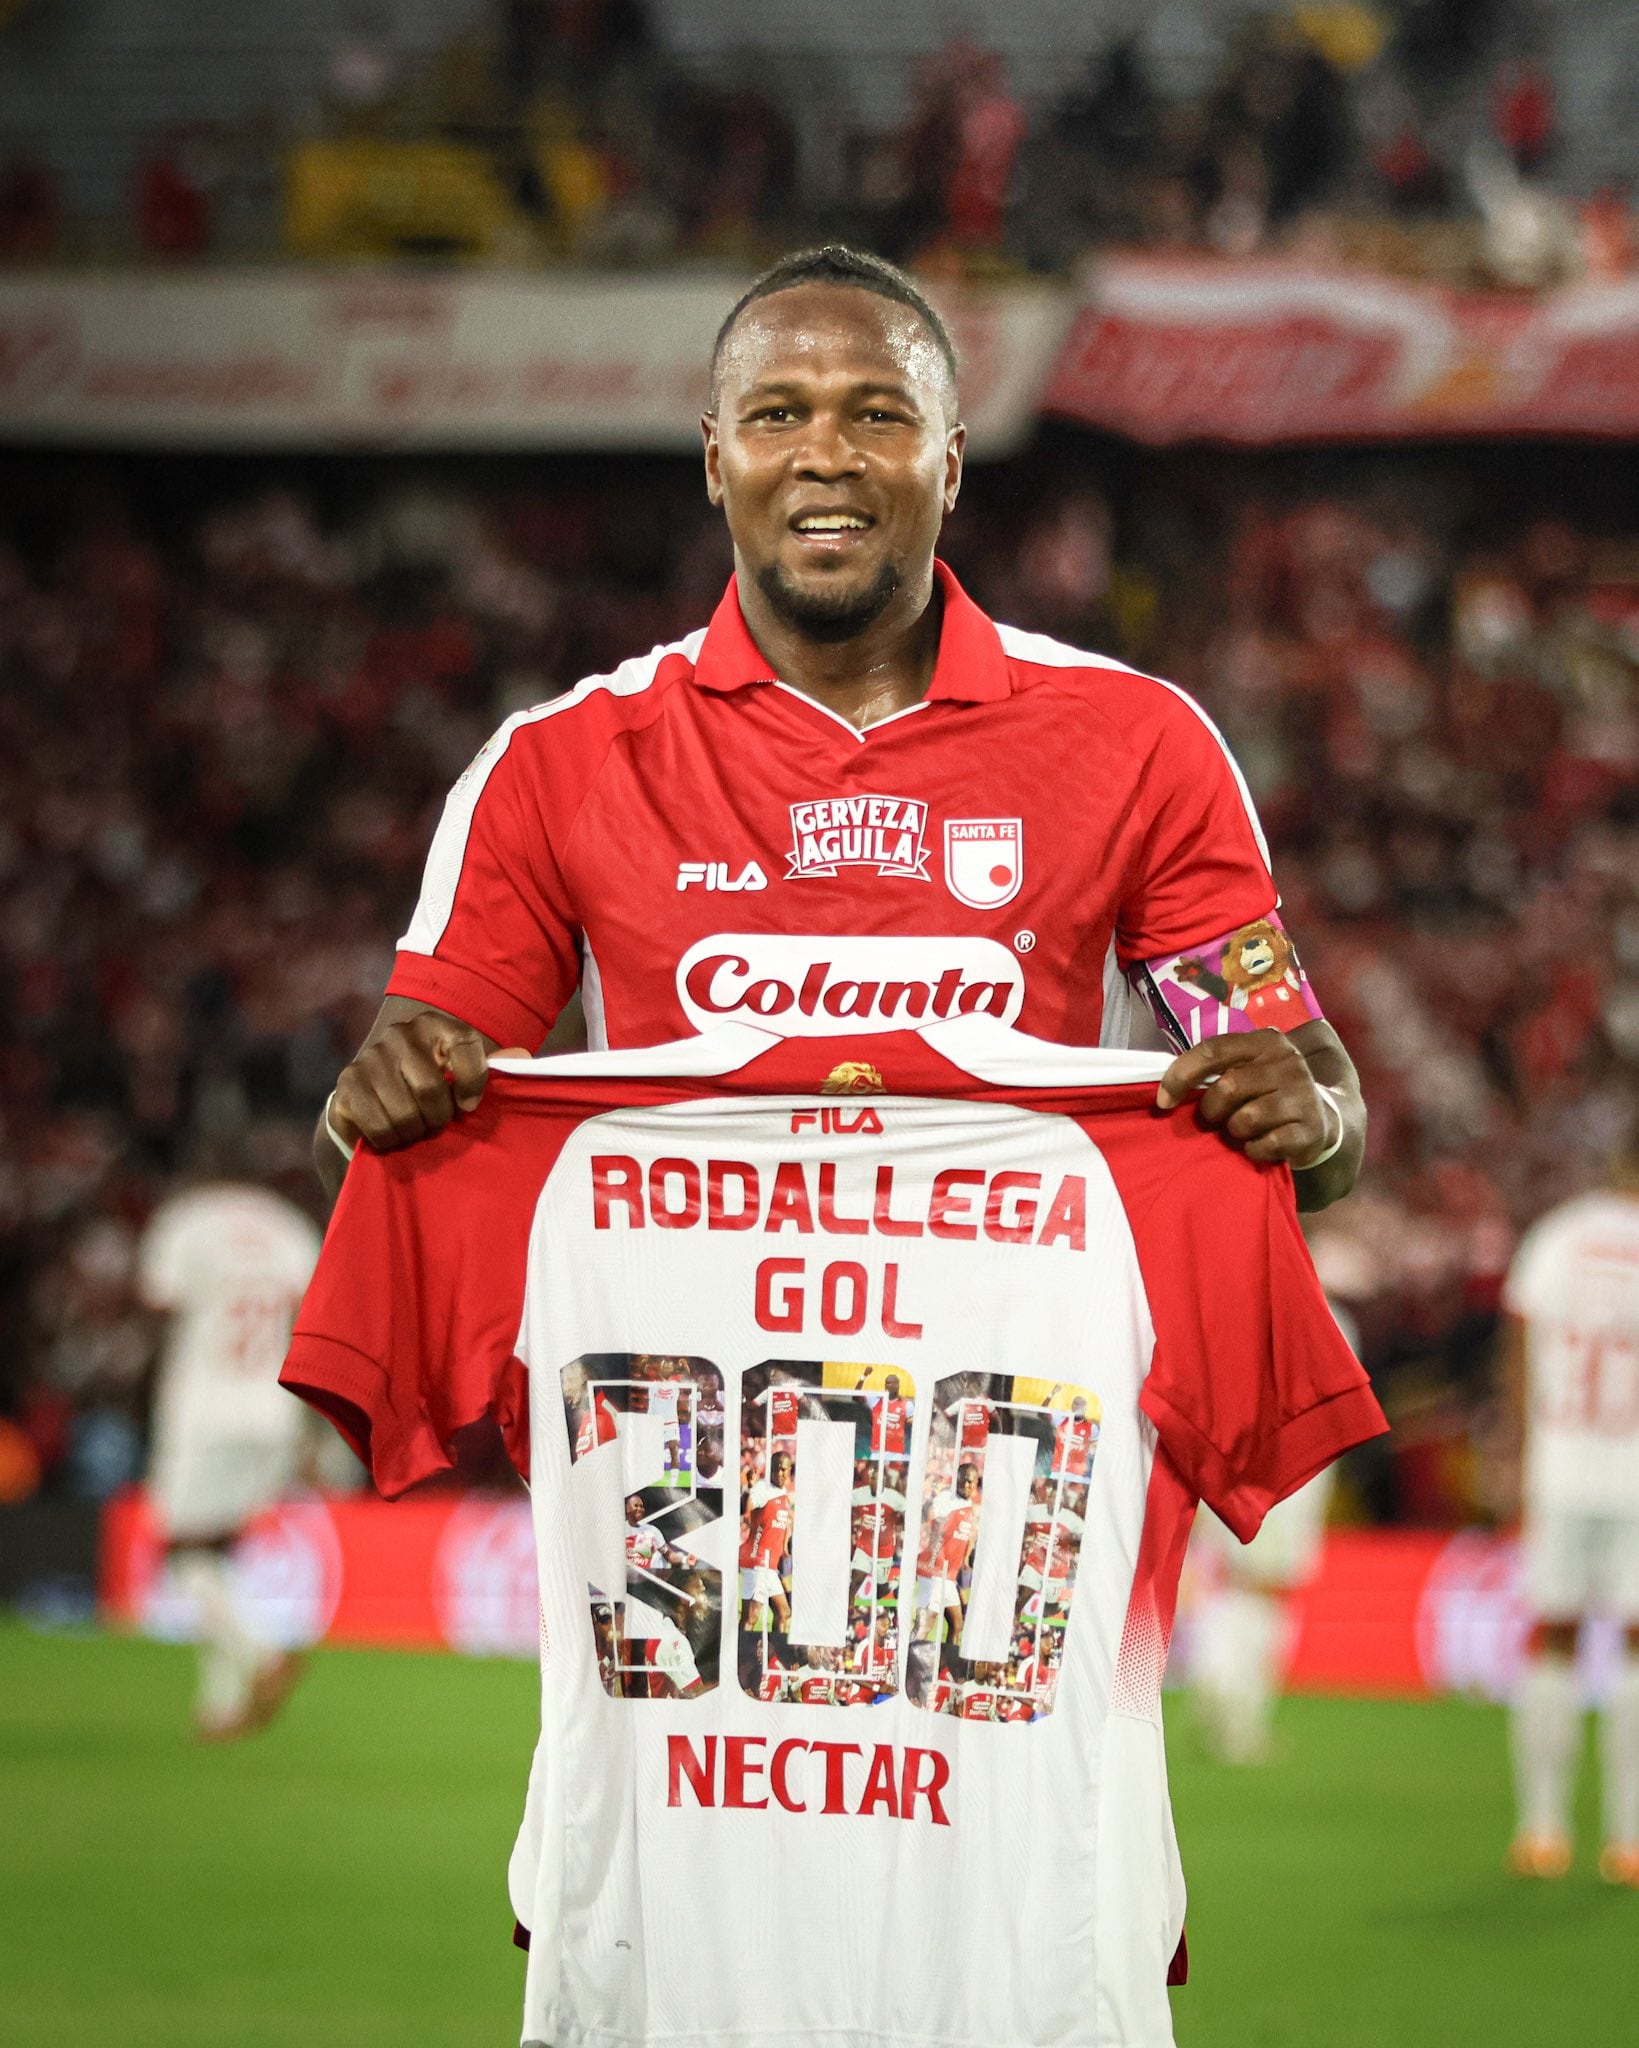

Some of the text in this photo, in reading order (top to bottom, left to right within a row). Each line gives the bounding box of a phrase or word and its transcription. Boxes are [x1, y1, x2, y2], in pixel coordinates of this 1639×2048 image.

[802, 828, 913, 868] AGUILA
[951, 825, 1017, 839] SANTA FE
[676, 861, 768, 892] FILA
[685, 954, 1014, 1019] Colanta
[790, 1107, 885, 1135] FILA
[590, 1154, 1087, 1252] RODALLEGA
[754, 1257, 923, 1341] GOL
[559, 1352, 1102, 1726] 300
[666, 1734, 951, 1827] NECTAR
